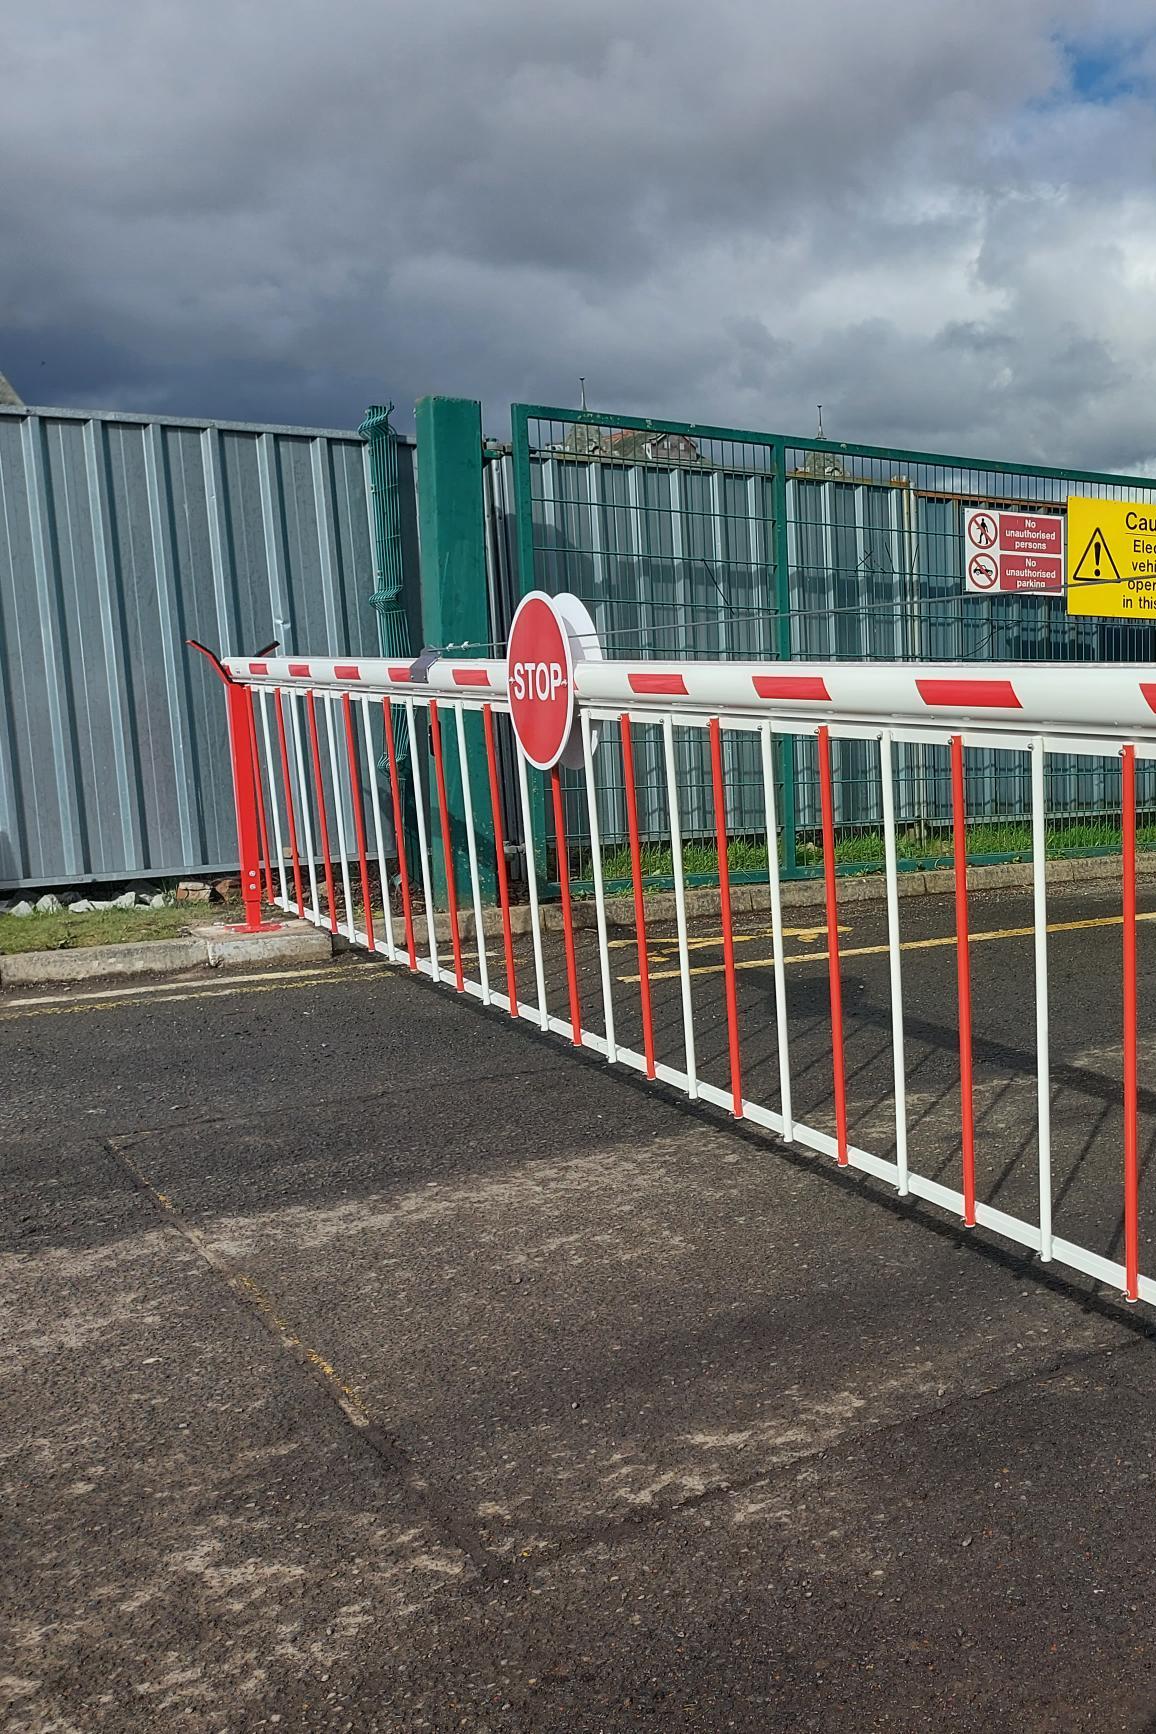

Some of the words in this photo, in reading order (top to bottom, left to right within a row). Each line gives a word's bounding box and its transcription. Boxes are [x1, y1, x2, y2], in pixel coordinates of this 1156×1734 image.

[1025, 519, 1037, 529] No
[1005, 529, 1056, 540] unauthorised
[1015, 541, 1047, 550] persons
[1025, 558, 1037, 567] No
[1005, 568, 1056, 579] unauthorised
[1122, 594, 1133, 608] in
[514, 662, 562, 701] STOP
